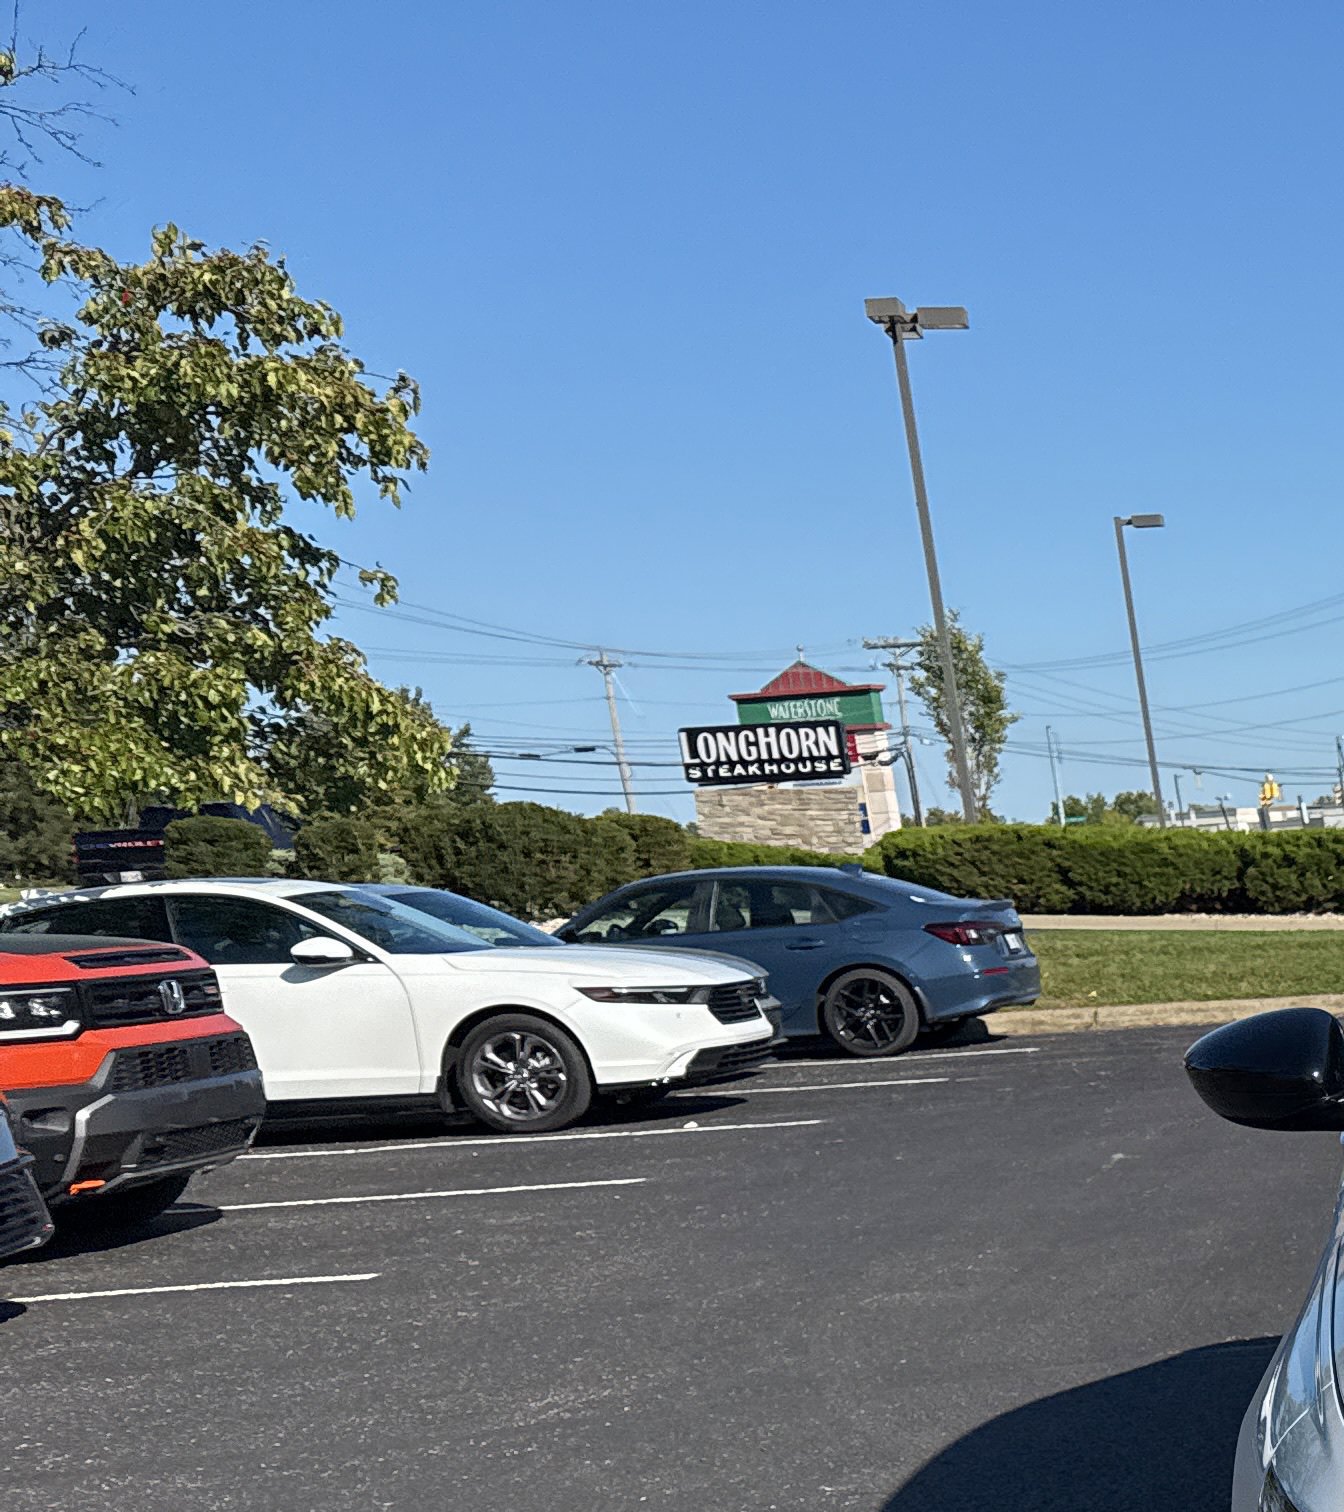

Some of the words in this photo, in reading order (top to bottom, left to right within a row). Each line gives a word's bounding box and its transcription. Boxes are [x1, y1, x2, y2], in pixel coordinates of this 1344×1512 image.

[767, 698, 842, 719] WATERSTONE
[679, 726, 840, 764] LONGHORN
[688, 757, 844, 779] STEAKHOUSE
